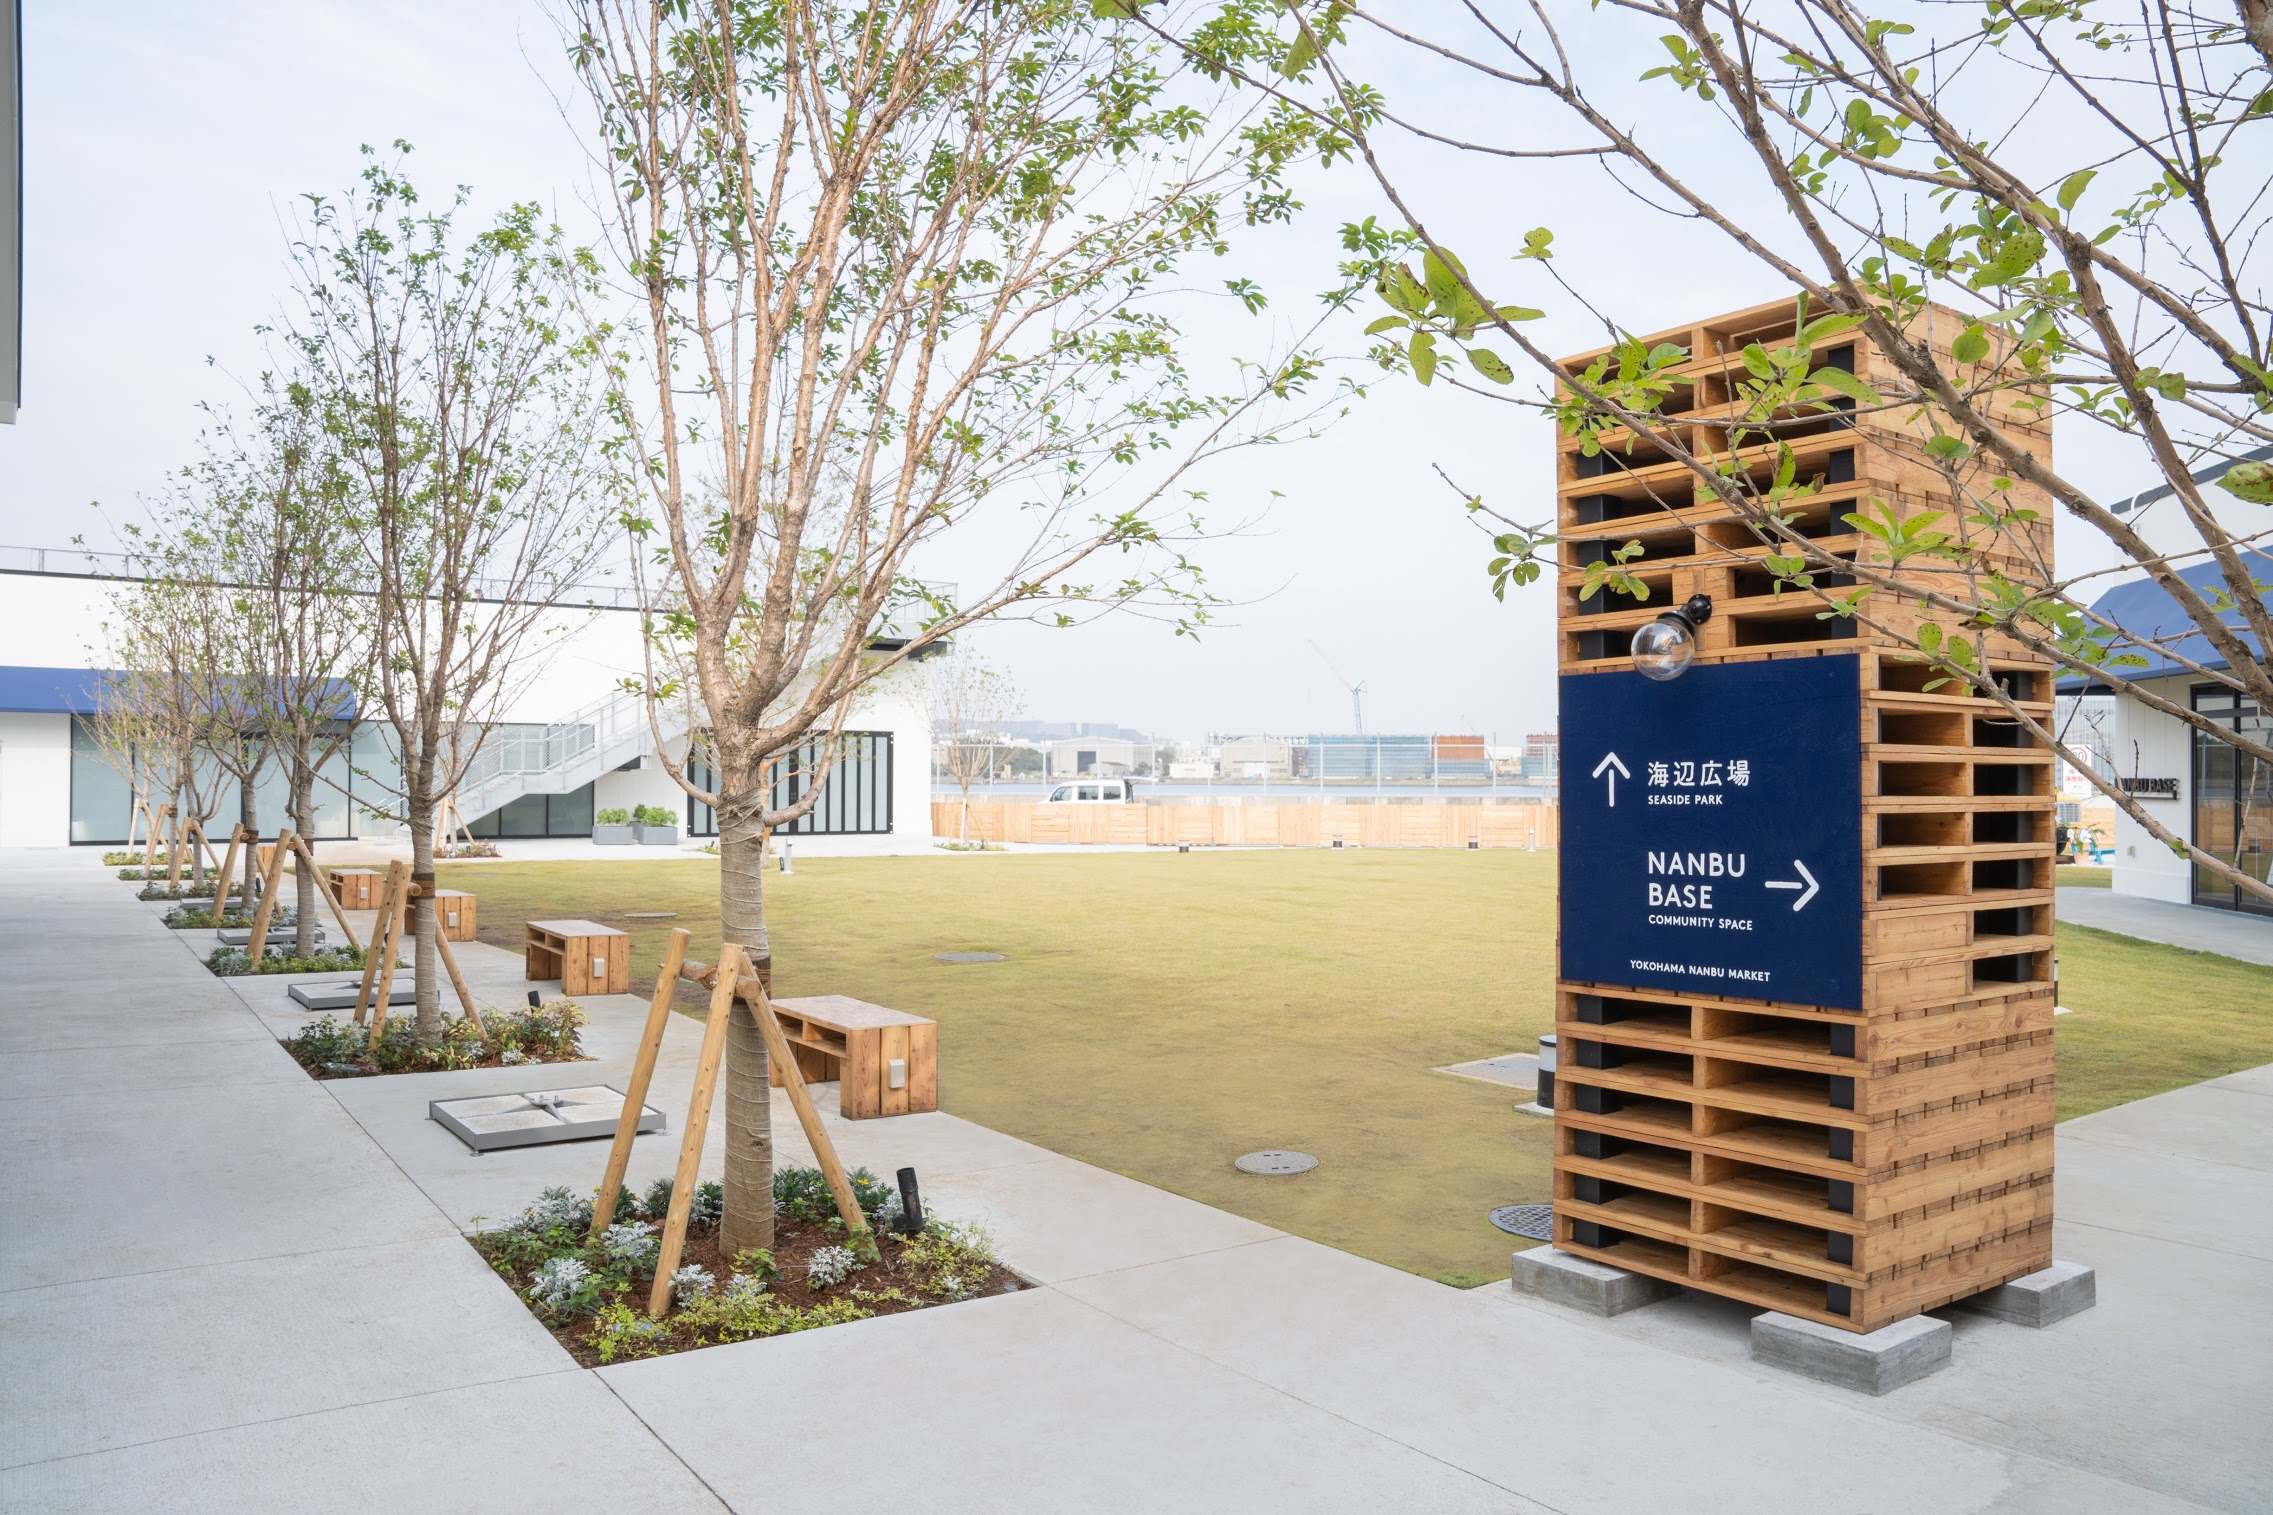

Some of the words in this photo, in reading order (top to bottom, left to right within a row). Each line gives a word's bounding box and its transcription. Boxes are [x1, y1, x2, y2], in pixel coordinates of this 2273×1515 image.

[1647, 759, 1751, 788] 海辺広場
[2150, 777, 2177, 793] BASE
[1647, 794, 1691, 805] SEASIDE
[1694, 794, 1723, 805] PARK
[1648, 851, 1746, 878] NANBU
[1648, 882, 1713, 910] BASE
[1648, 914, 1715, 929] COMMUNITY
[1718, 918, 1753, 931] SPACE
[1629, 959, 1686, 974] YOKOHAMA
[1688, 965, 1725, 978] NANBU
[1728, 968, 1771, 982] MARKET
